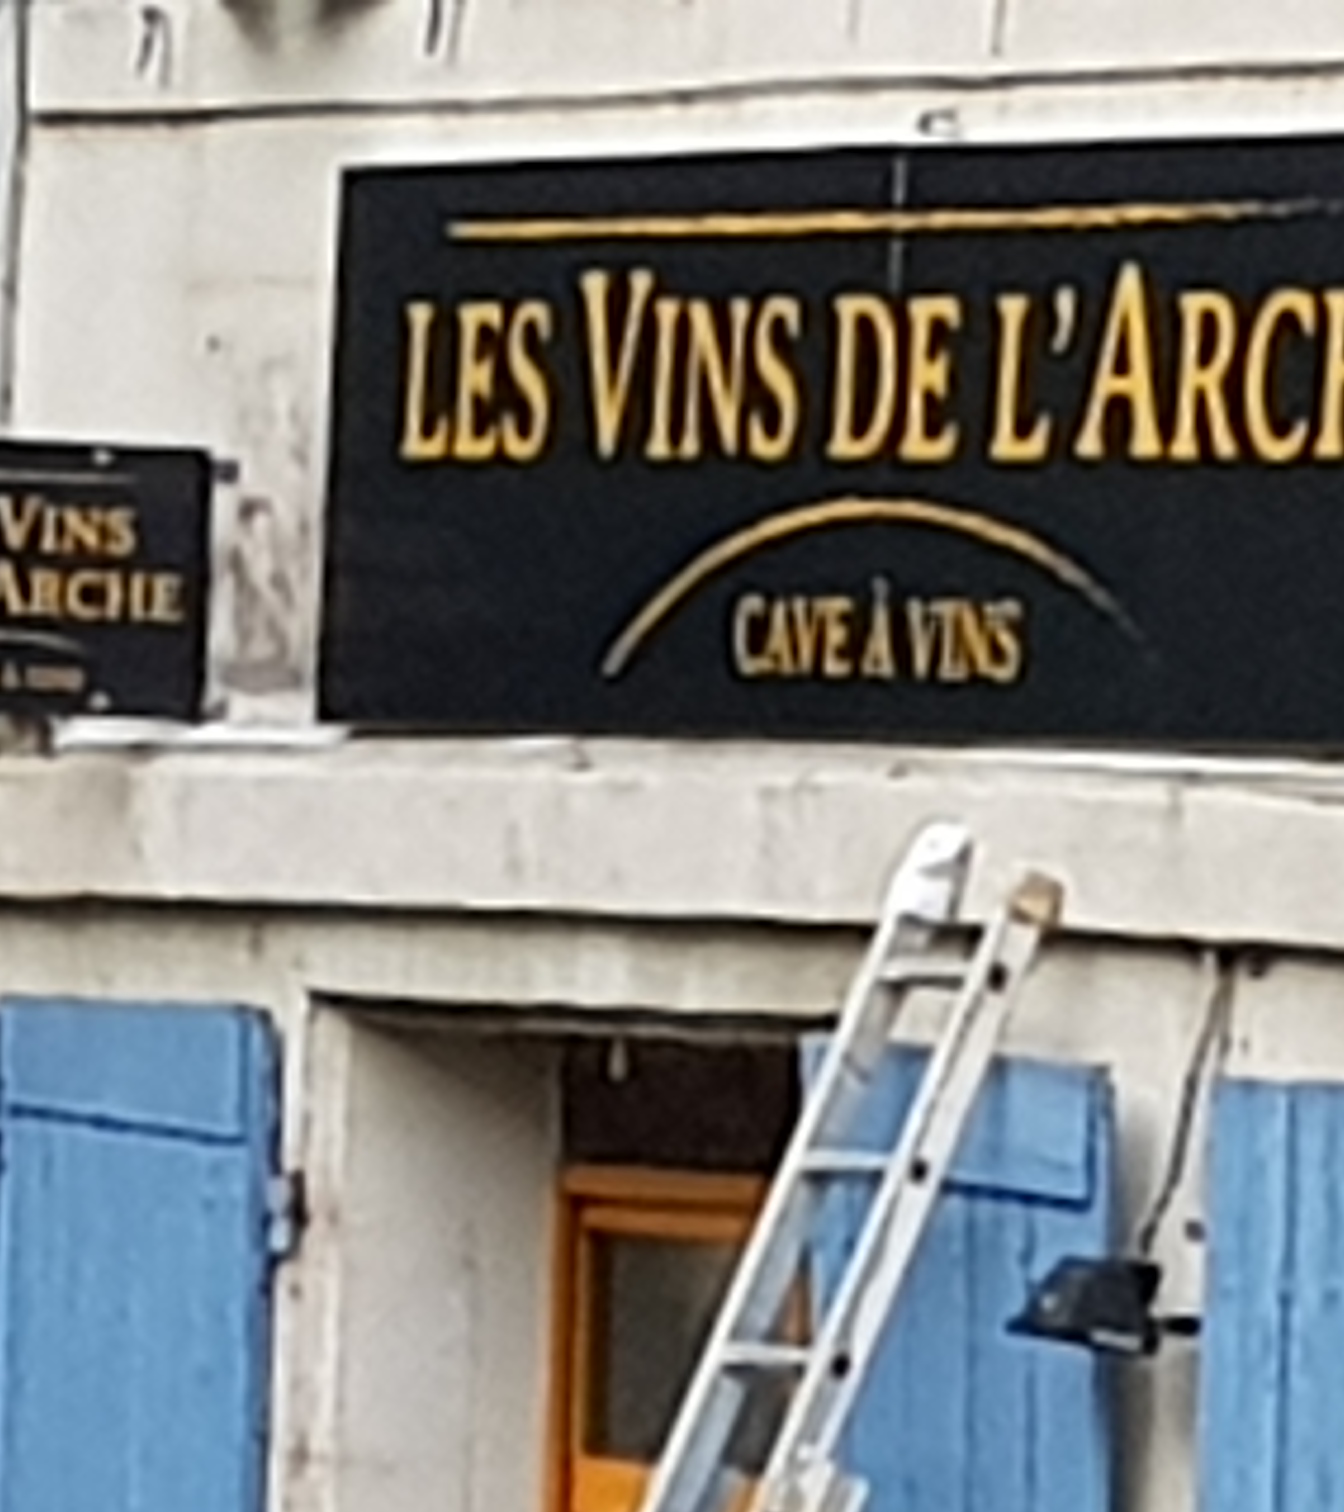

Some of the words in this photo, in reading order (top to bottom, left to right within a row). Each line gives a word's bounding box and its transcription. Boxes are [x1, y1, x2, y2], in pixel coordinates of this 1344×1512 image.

[399, 300, 552, 463] LES
[579, 269, 802, 463] VINS
[827, 293, 964, 464] DE
[734, 593, 854, 676] CAVE
[908, 596, 1023, 682] VINS
